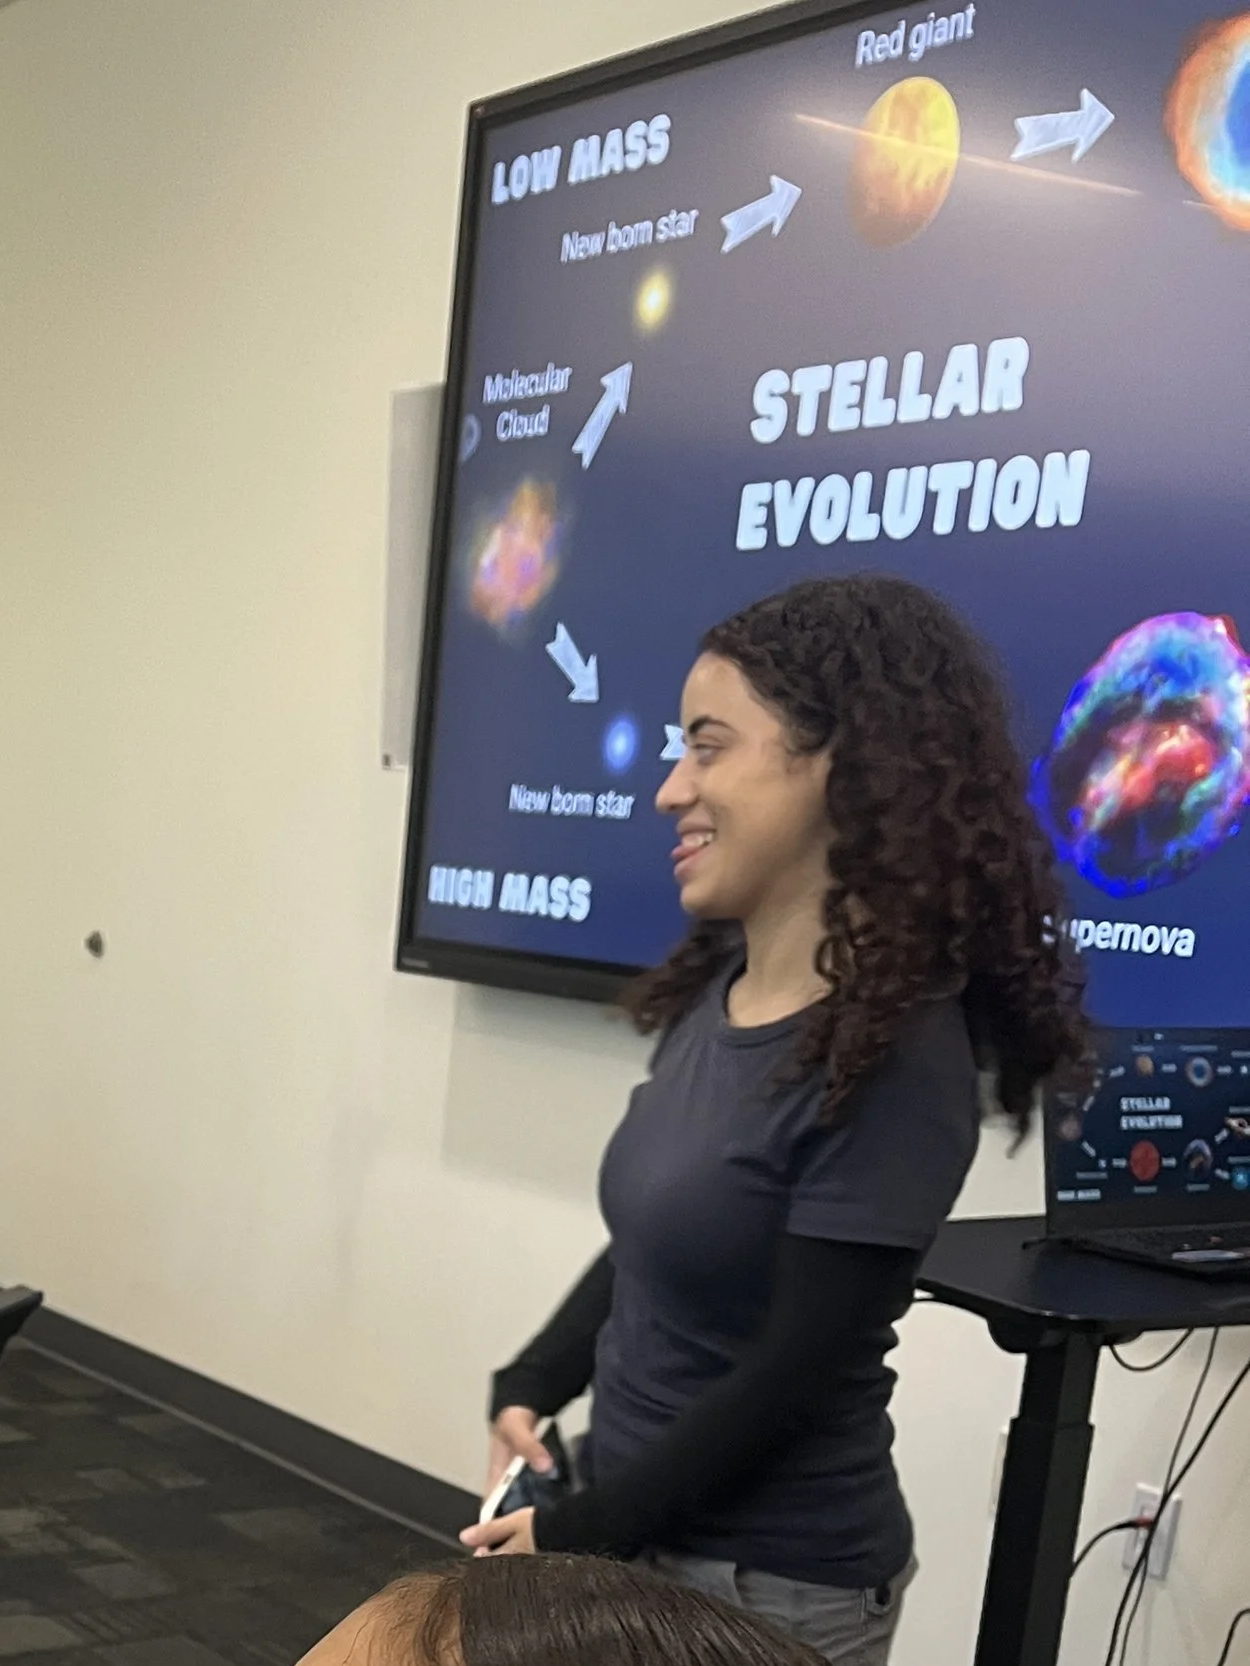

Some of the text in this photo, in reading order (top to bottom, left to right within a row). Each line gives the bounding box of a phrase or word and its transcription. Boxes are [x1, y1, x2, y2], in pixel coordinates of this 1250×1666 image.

[855, 2, 977, 69] Red giant
[491, 113, 671, 205] LOW MASS
[560, 208, 700, 263] New born star
[482, 361, 573, 405] Molecular
[750, 336, 1030, 444] STELLAR
[496, 403, 551, 442] Cloud
[735, 449, 1091, 551] EVOLUTION
[507, 783, 636, 820] New born star
[427, 864, 592, 923] HIGH MASS
